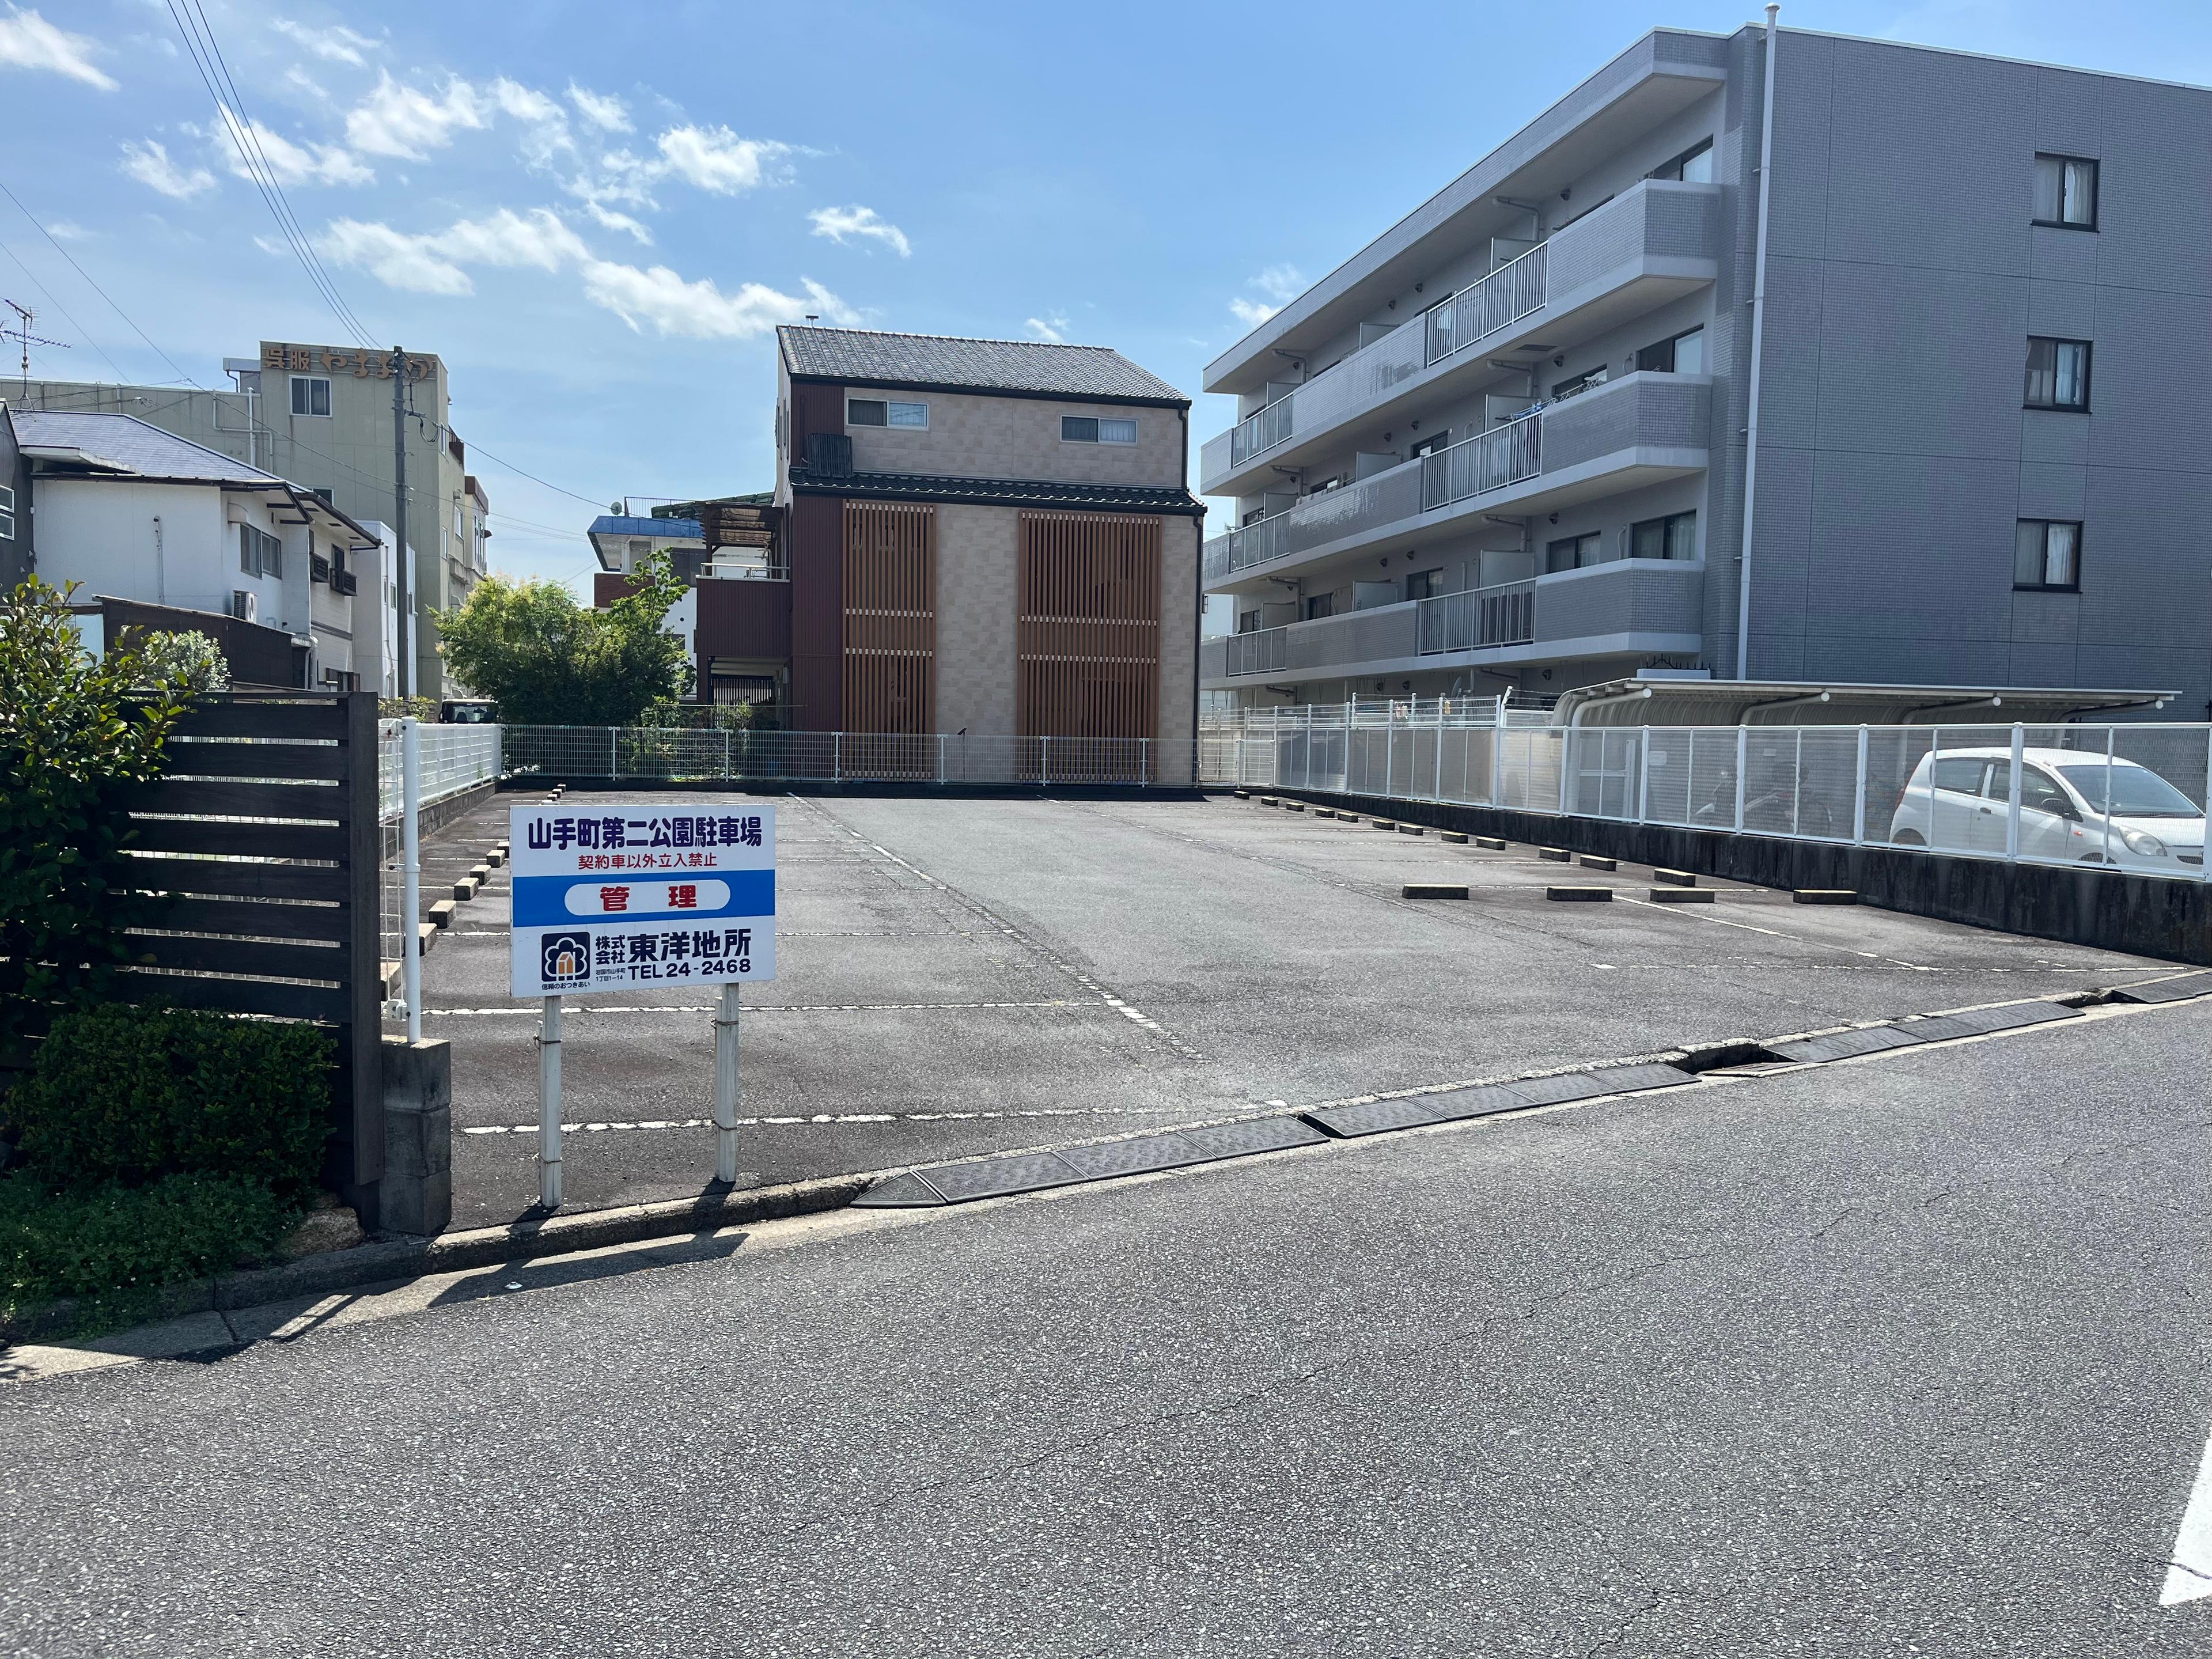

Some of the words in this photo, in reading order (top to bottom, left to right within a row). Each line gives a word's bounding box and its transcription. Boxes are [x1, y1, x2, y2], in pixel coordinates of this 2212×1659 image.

[528, 816, 762, 850] 山手町第二公園駐車場
[578, 853, 718, 870] 契約車以外立入禁止
[600, 885, 697, 911] 管理
[627, 929, 751, 963] 東洋地所
[541, 982, 590, 990] 信頼のおつきあい
